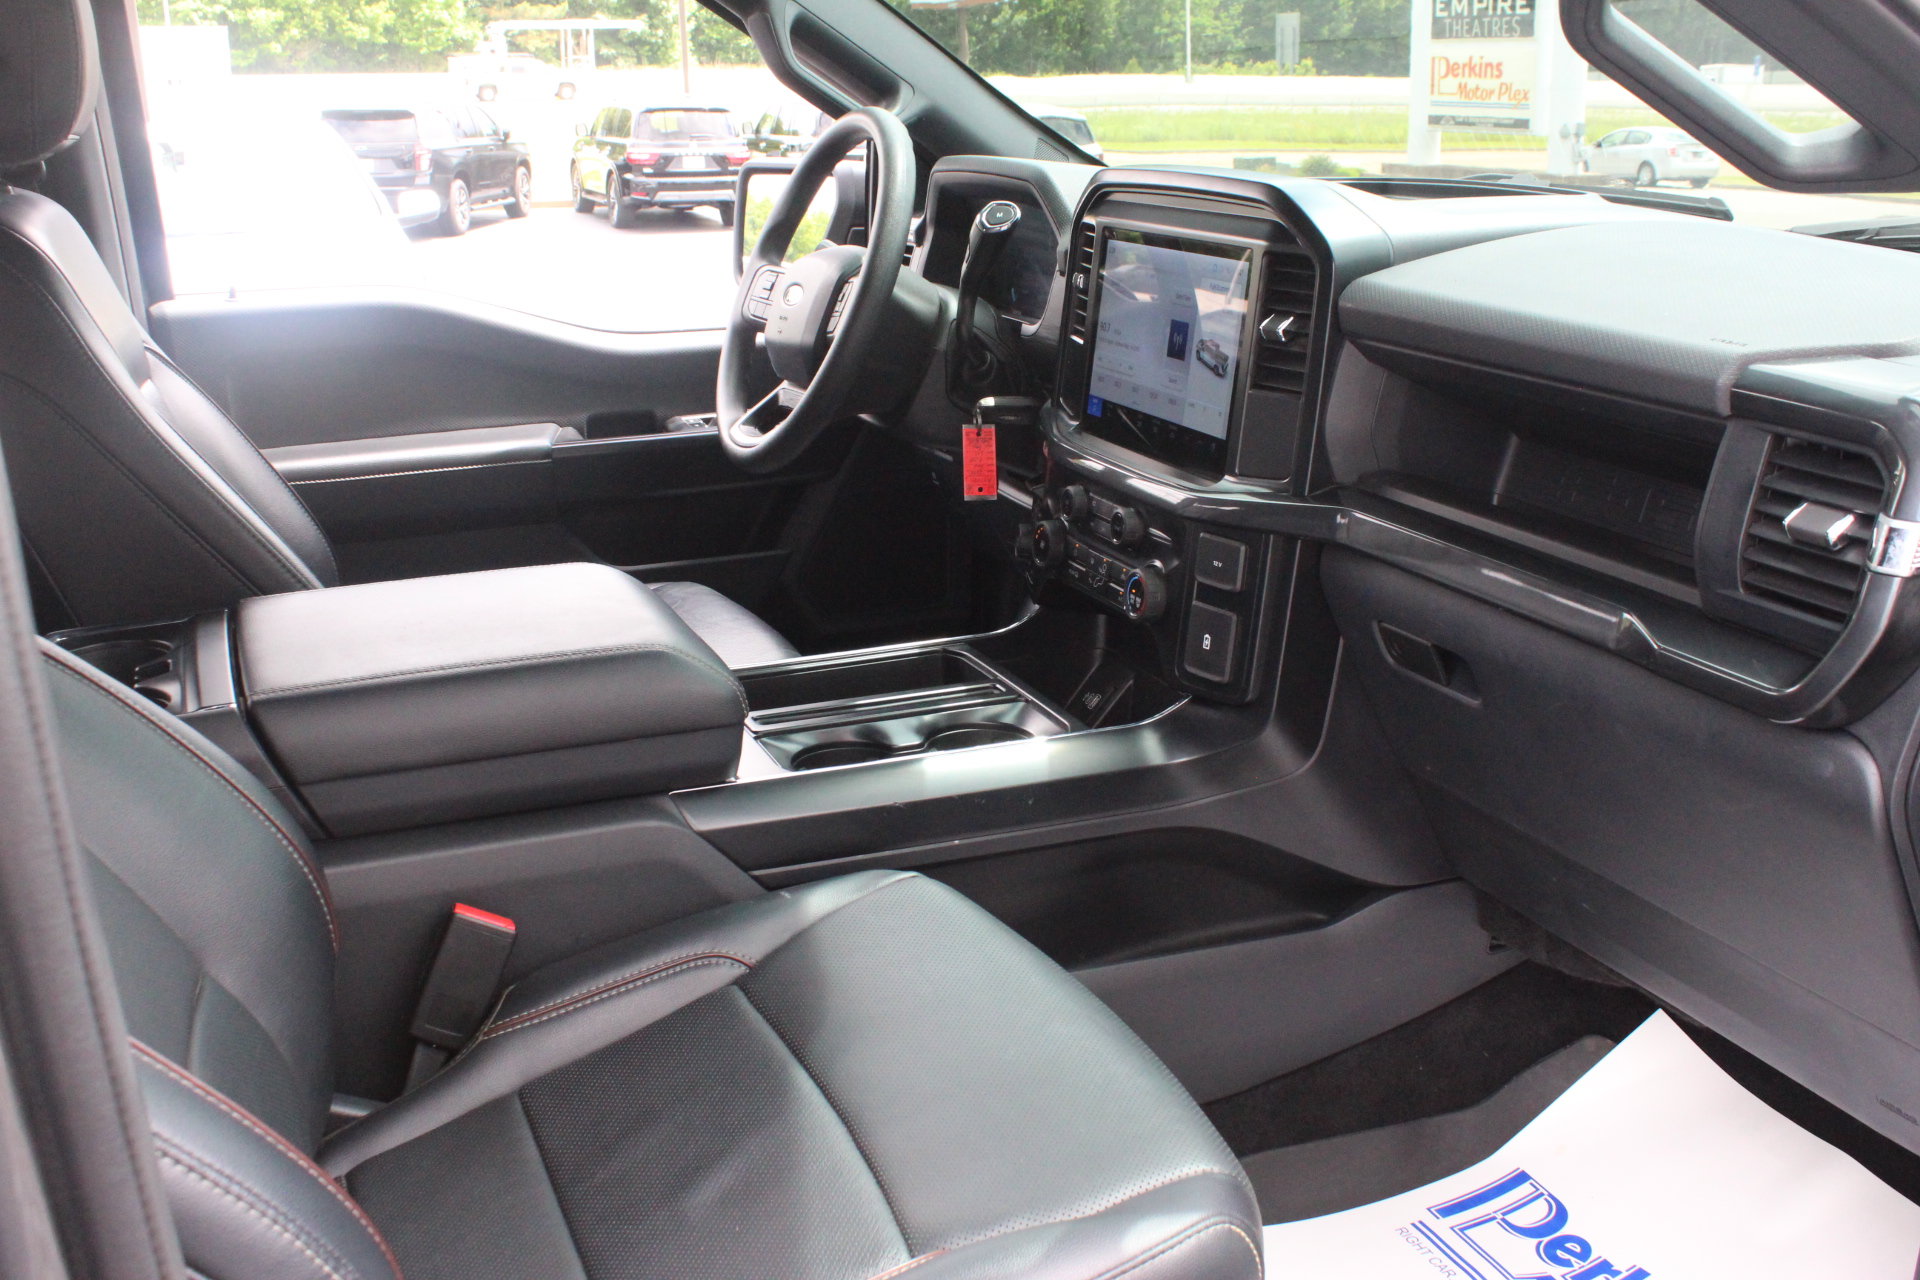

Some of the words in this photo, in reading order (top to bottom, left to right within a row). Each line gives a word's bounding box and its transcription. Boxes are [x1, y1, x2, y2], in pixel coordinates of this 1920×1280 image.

[1435, 0, 1531, 17] EMPIRE
[1443, 16, 1521, 38] THEATRES
[1430, 56, 1503, 95] Perkins
[1458, 81, 1496, 101] Motor
[1497, 81, 1530, 109] Plex
[1395, 1226, 1434, 1256] RIGHT
